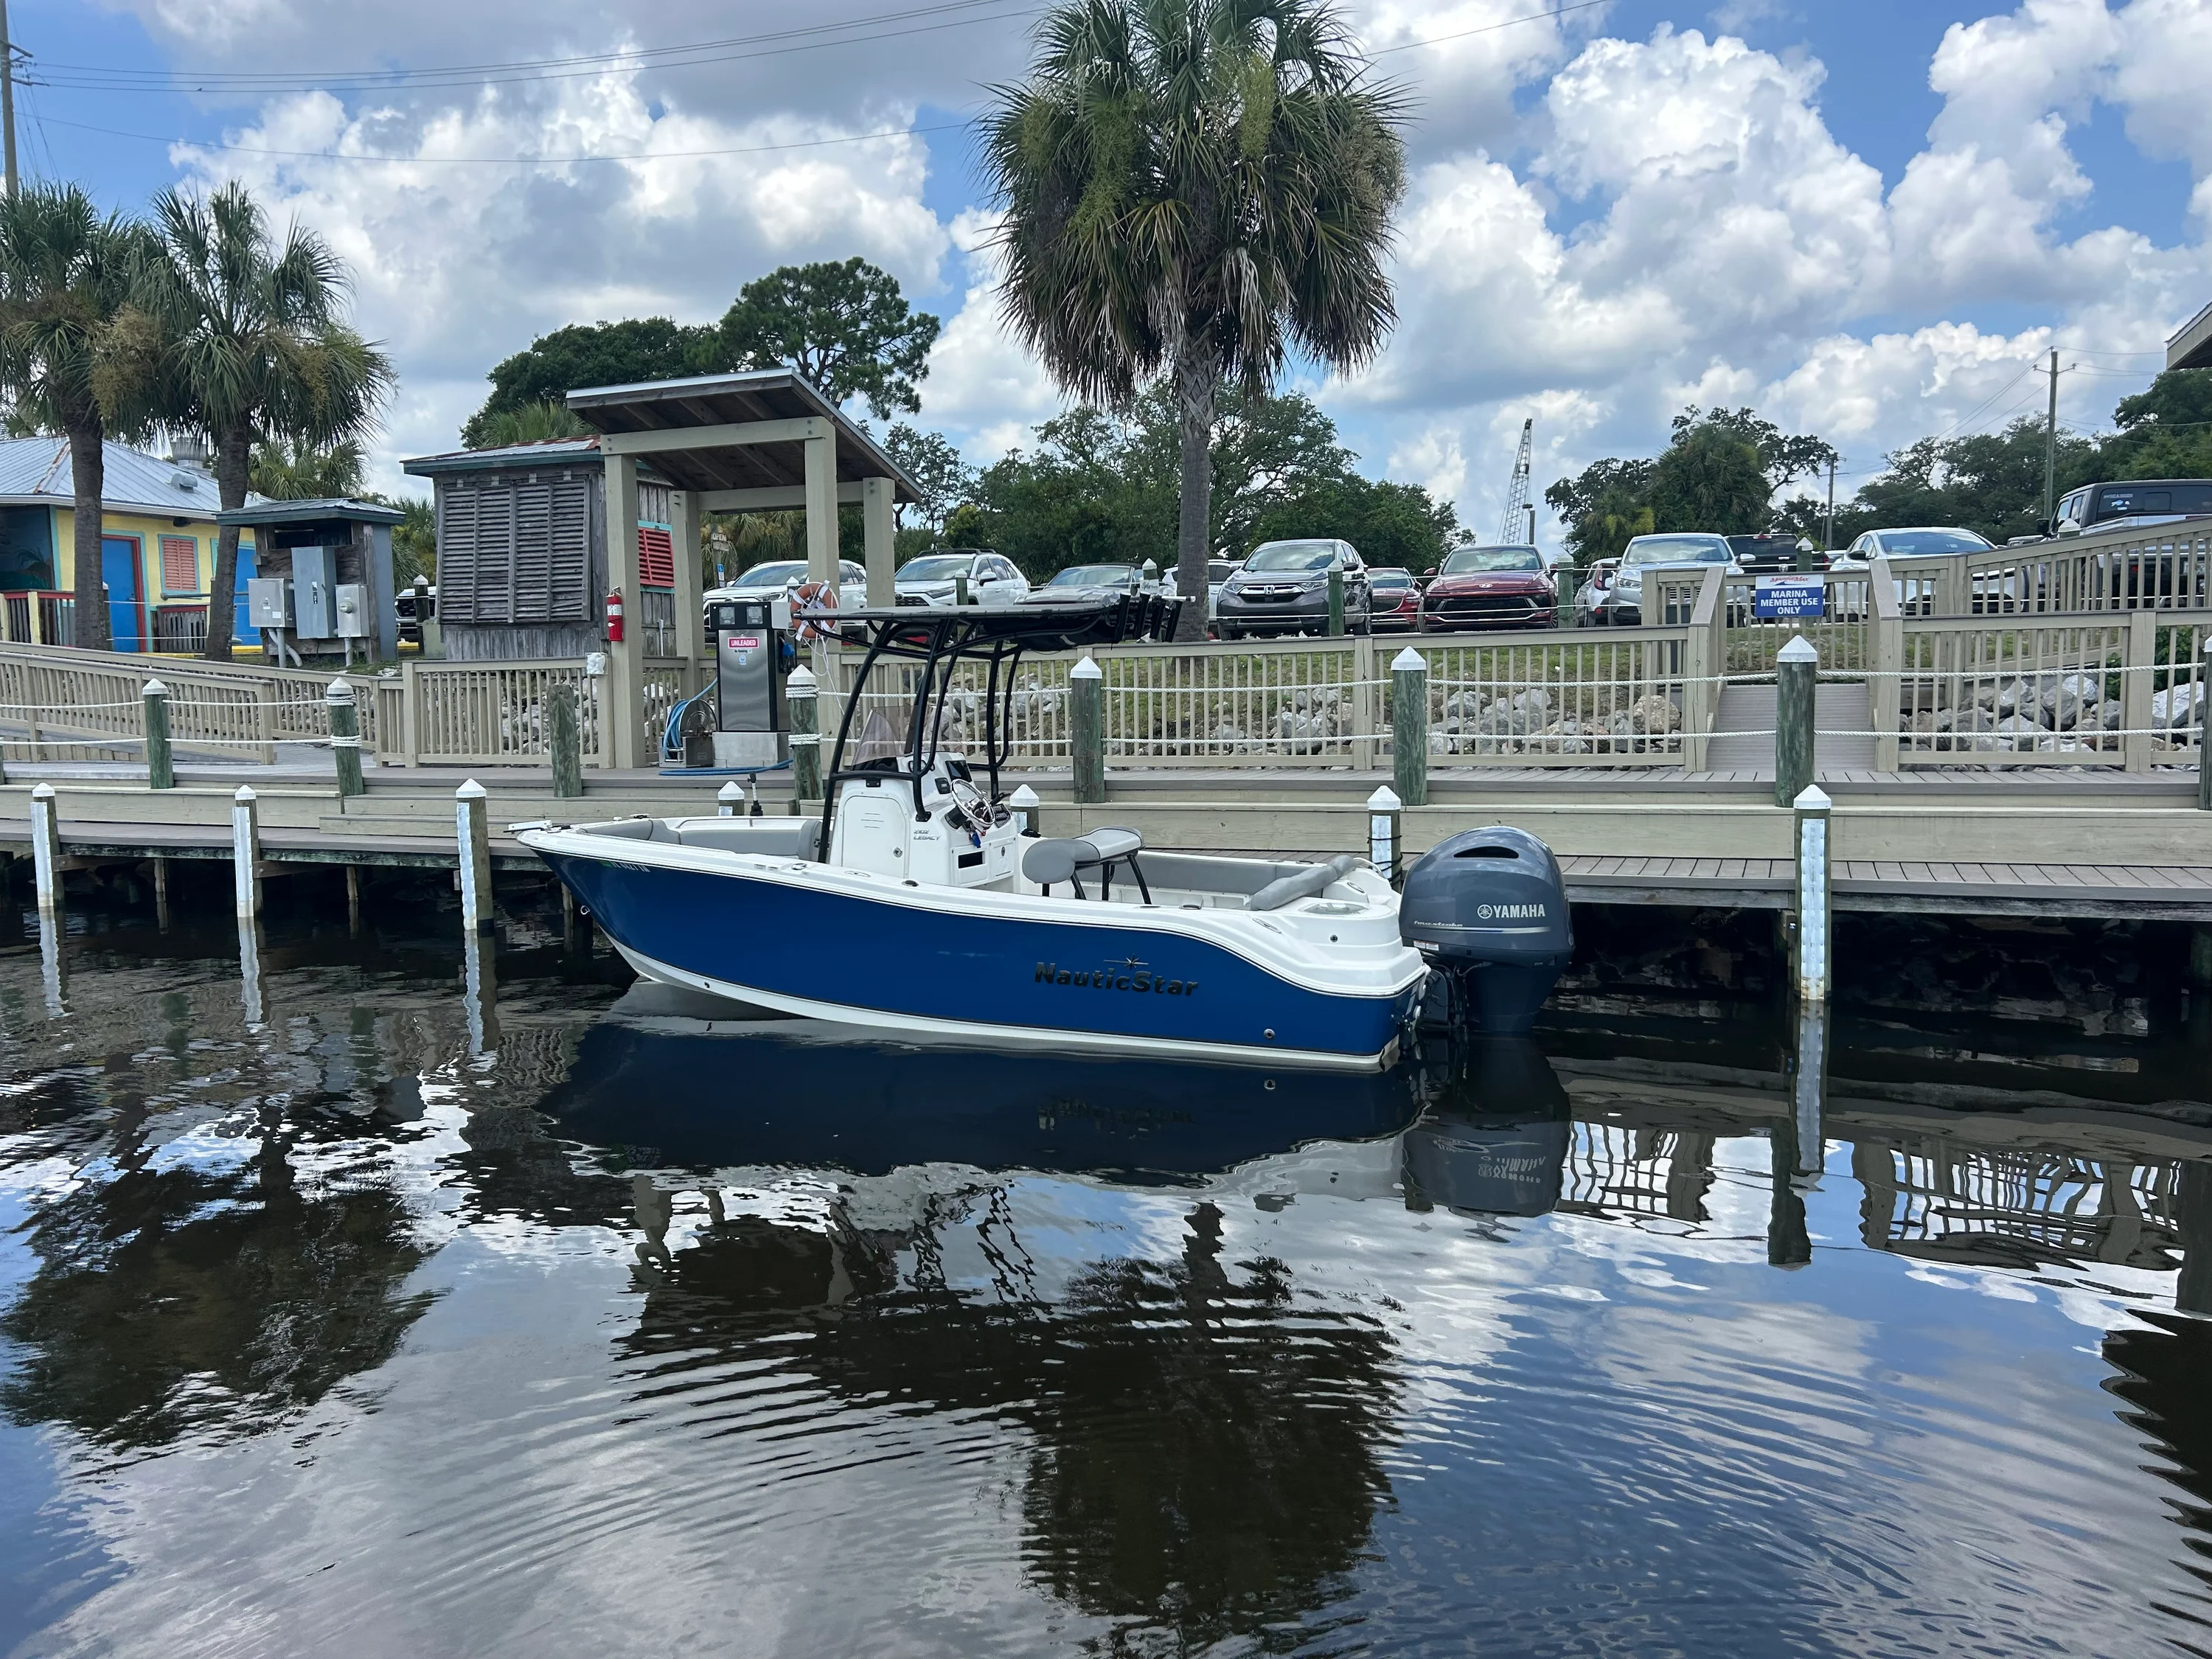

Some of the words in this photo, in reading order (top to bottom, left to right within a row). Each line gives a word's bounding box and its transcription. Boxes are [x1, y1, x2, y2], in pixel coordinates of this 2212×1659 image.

[1771, 590, 1807, 598] MARINA
[1760, 598, 1798, 607] MEMBER
[1801, 597, 1818, 605] USE
[1777, 606, 1801, 614] ONLY
[1492, 903, 1545, 918] YAMAHA
[1034, 961, 1198, 995] NauticStar
